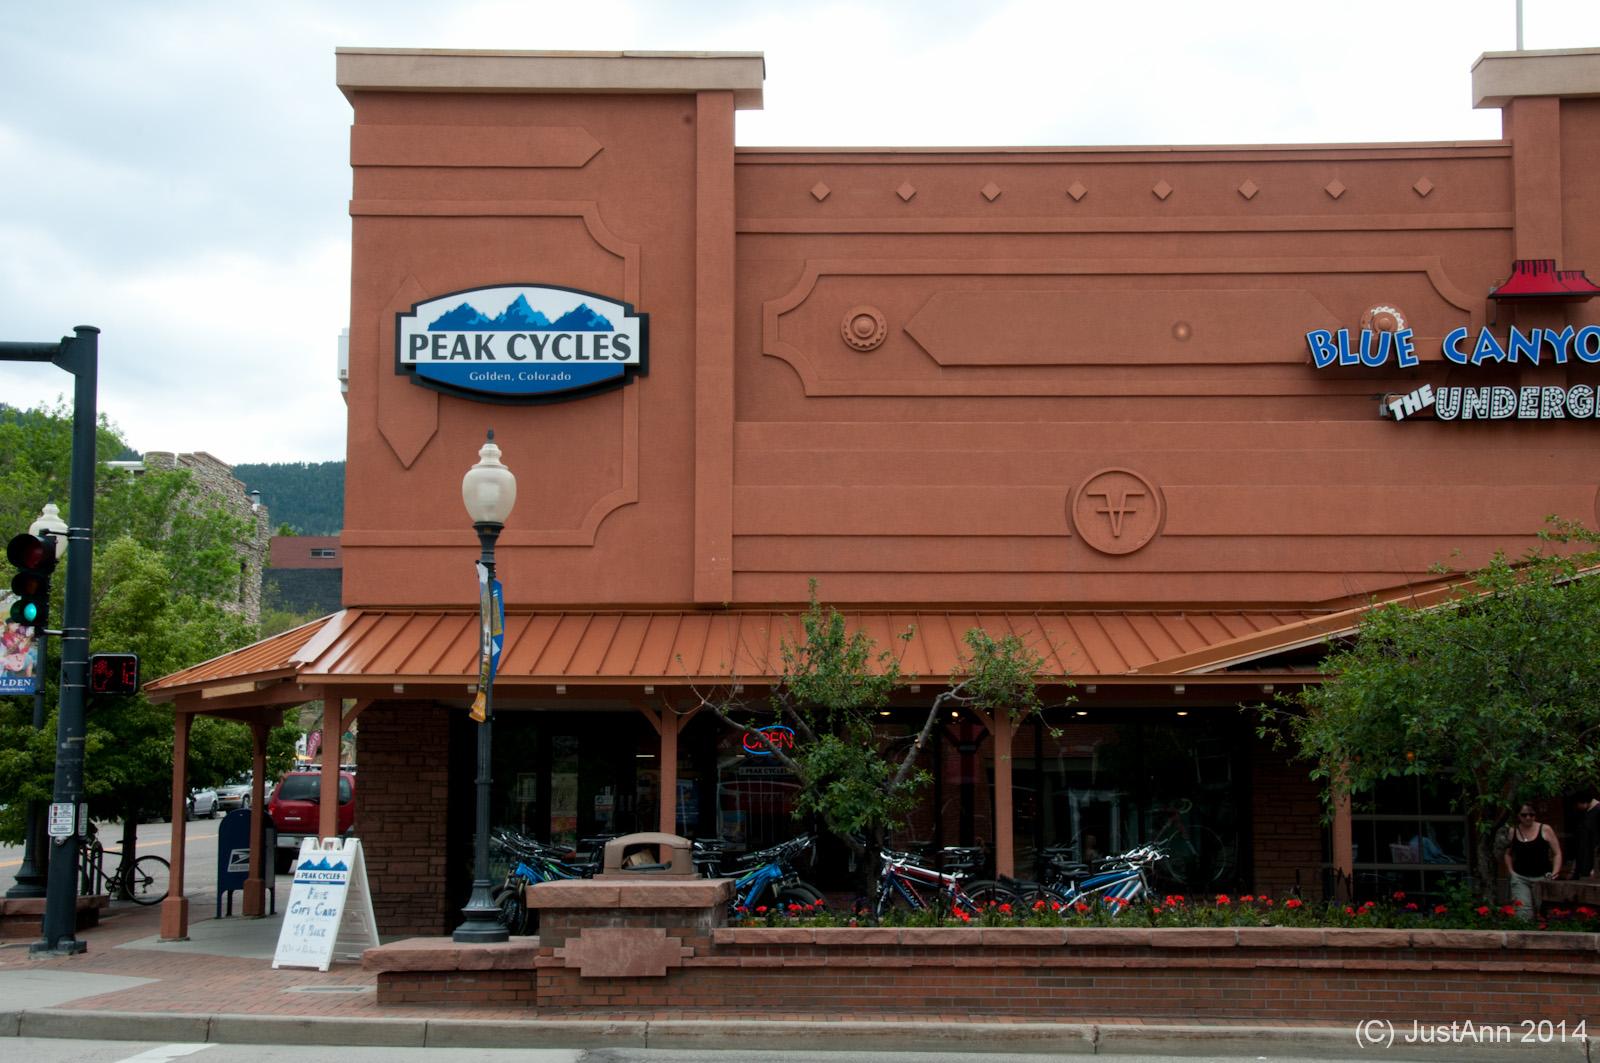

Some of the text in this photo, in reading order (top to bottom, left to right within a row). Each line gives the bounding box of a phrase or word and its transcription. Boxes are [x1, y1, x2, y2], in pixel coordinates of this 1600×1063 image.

[409, 333, 632, 361] PEAK CYCLES
[1306, 328, 1420, 369] BLUE
[469, 371, 572, 382] Golden, Colorado
[1389, 384, 1600, 421] THE UNDERG
[0, 678, 31, 687] LDEN
[318, 872, 340, 880] CYCLES
